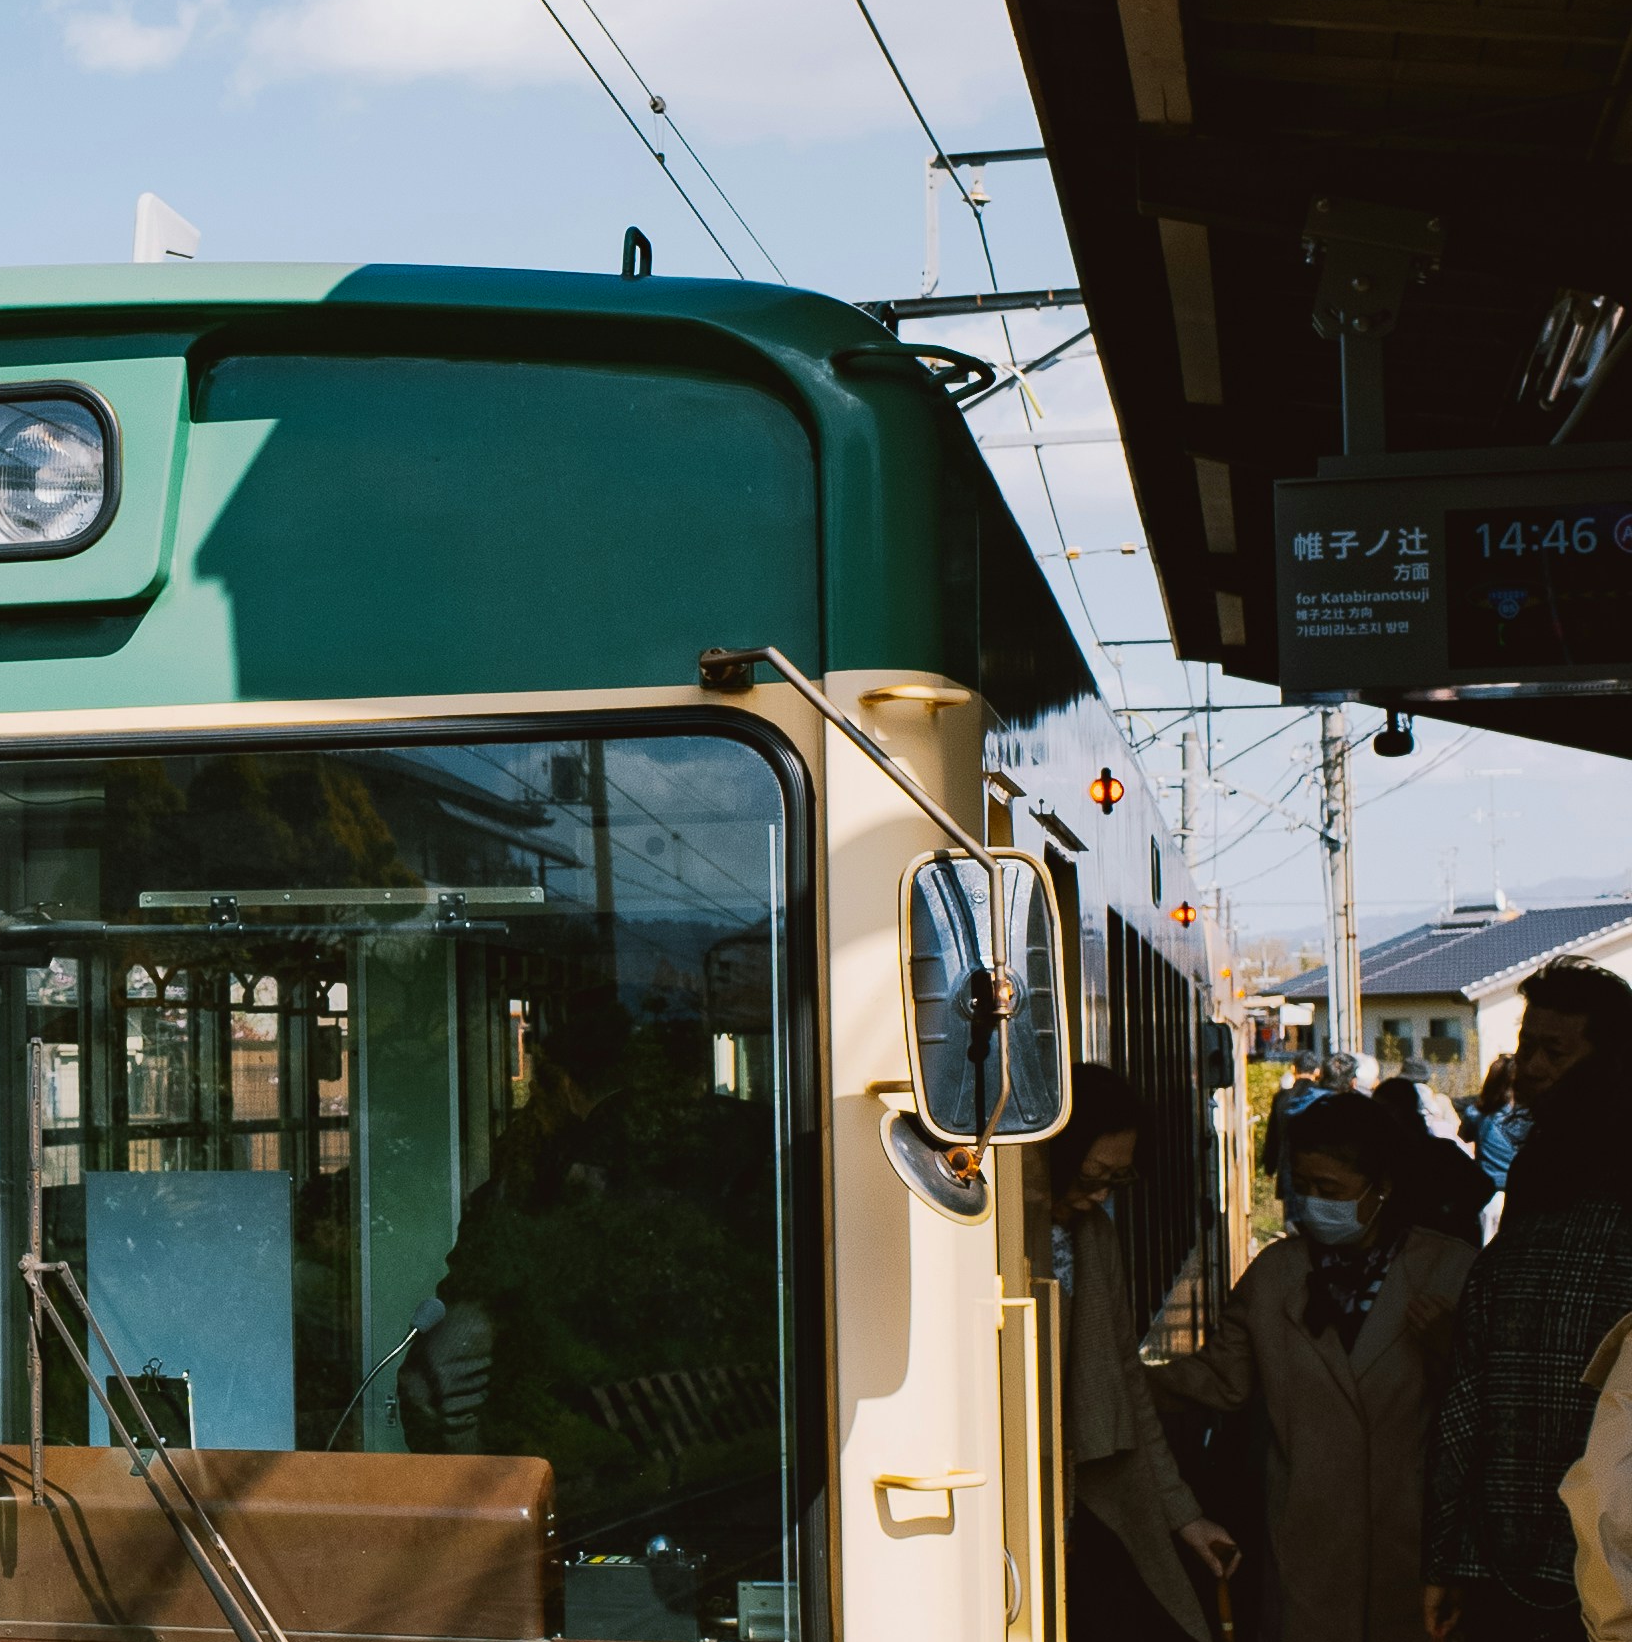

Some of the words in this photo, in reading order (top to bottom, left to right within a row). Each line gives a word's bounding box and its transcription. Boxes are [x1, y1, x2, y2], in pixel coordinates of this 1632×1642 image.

[1294, 526, 1429, 562] 帷子ノ辻
[1475, 516, 1599, 559] 14:46
[1393, 562, 1430, 581] 方面
[1296, 592, 1317, 605] for
[1321, 587, 1430, 604] Katabiranotsuji
